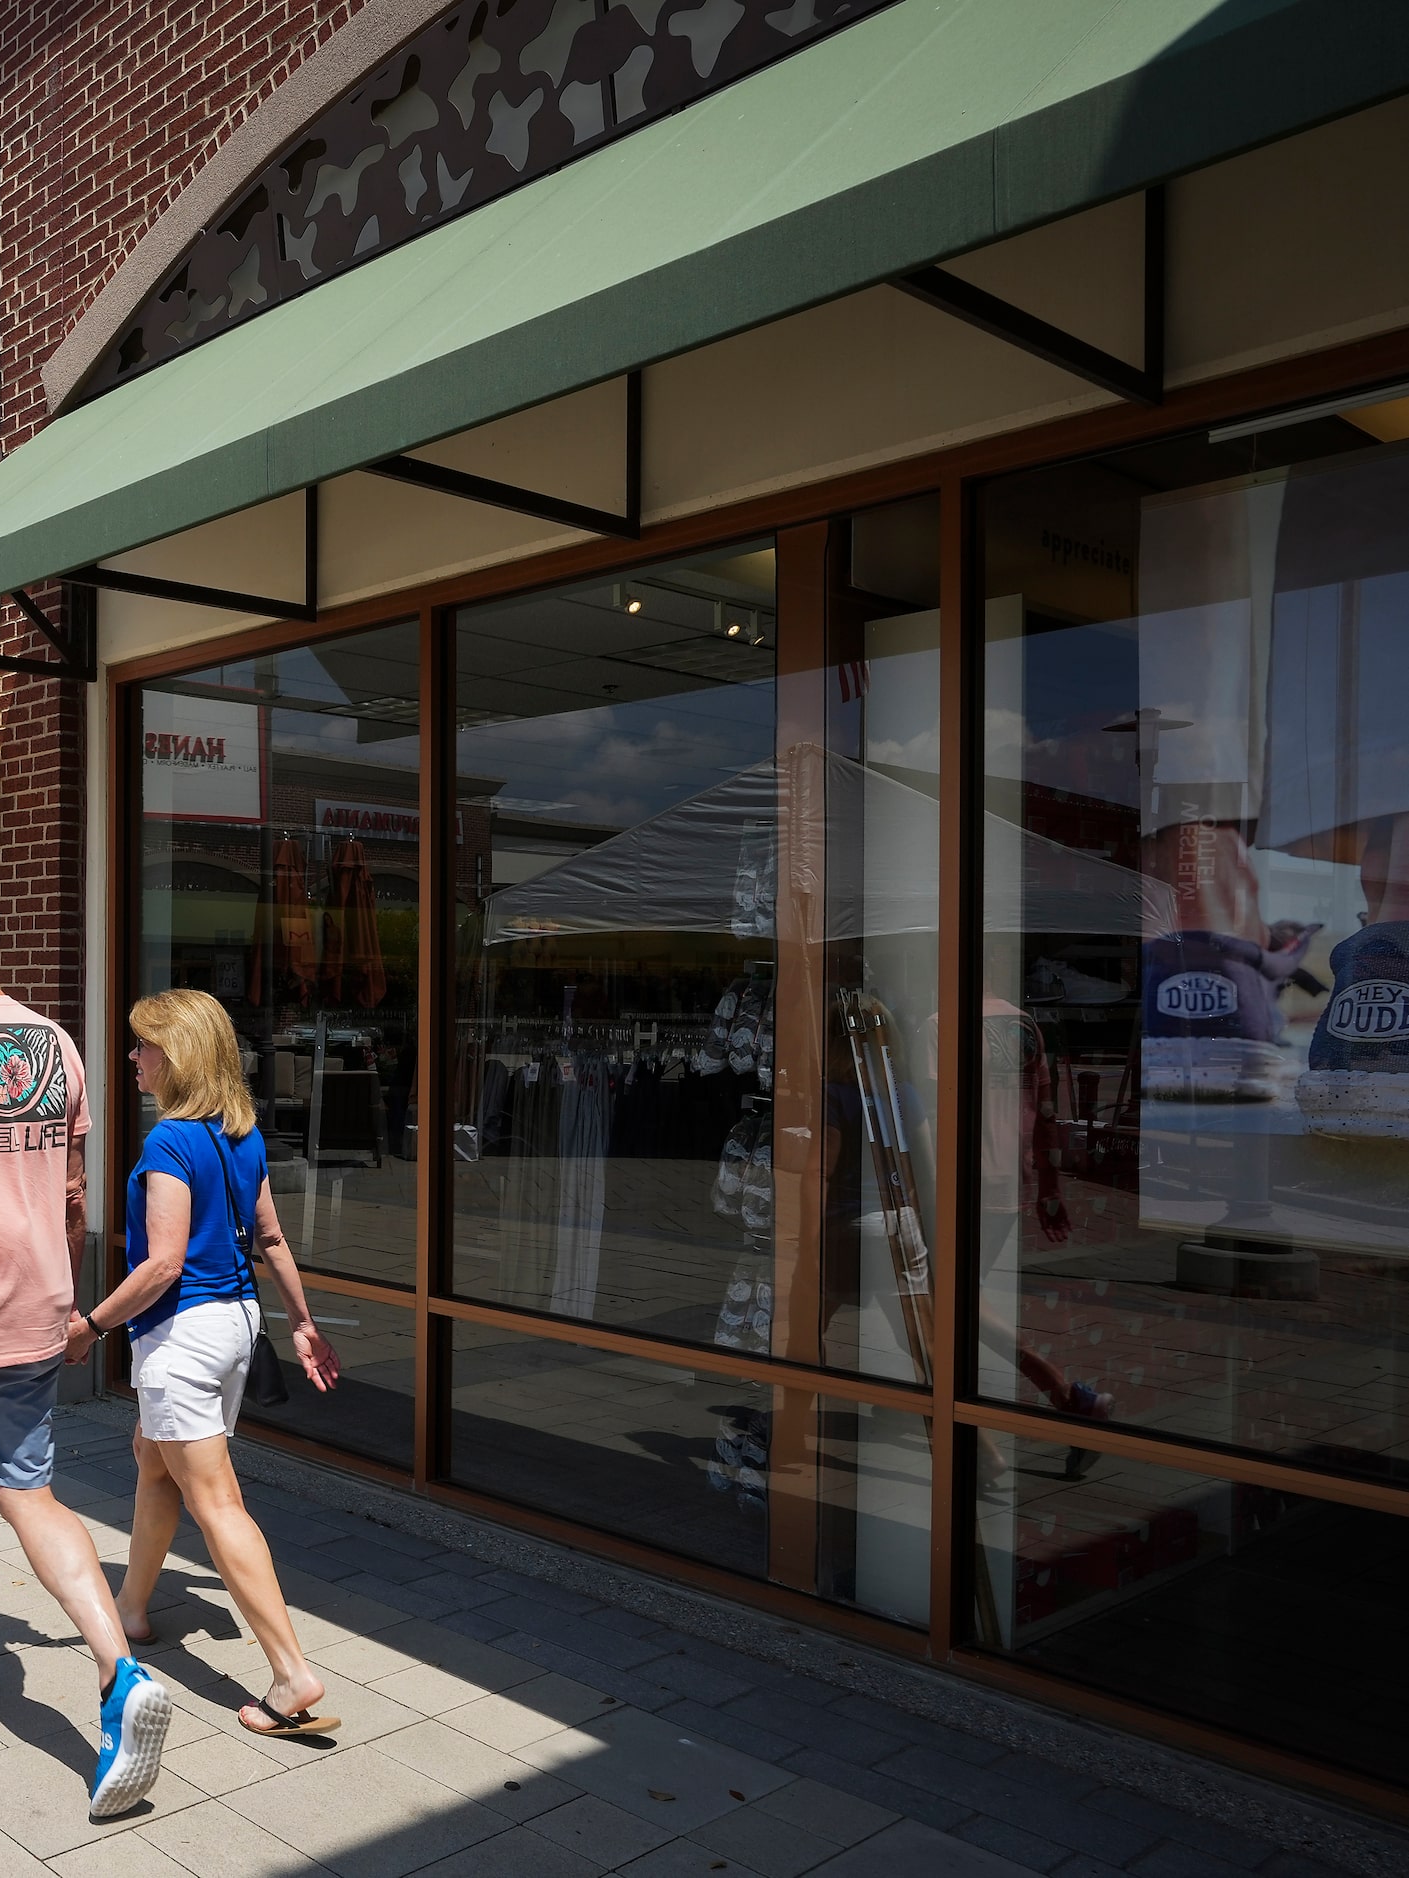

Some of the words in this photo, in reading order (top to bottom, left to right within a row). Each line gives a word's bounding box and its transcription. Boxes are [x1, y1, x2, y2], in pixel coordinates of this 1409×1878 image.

[1042, 529, 1130, 574] appreciate
[1182, 978, 1214, 991] HEY
[1356, 986, 1403, 1004] HEY
[1167, 985, 1228, 1012] DUDE
[24, 1122, 67, 1152] LIFE
